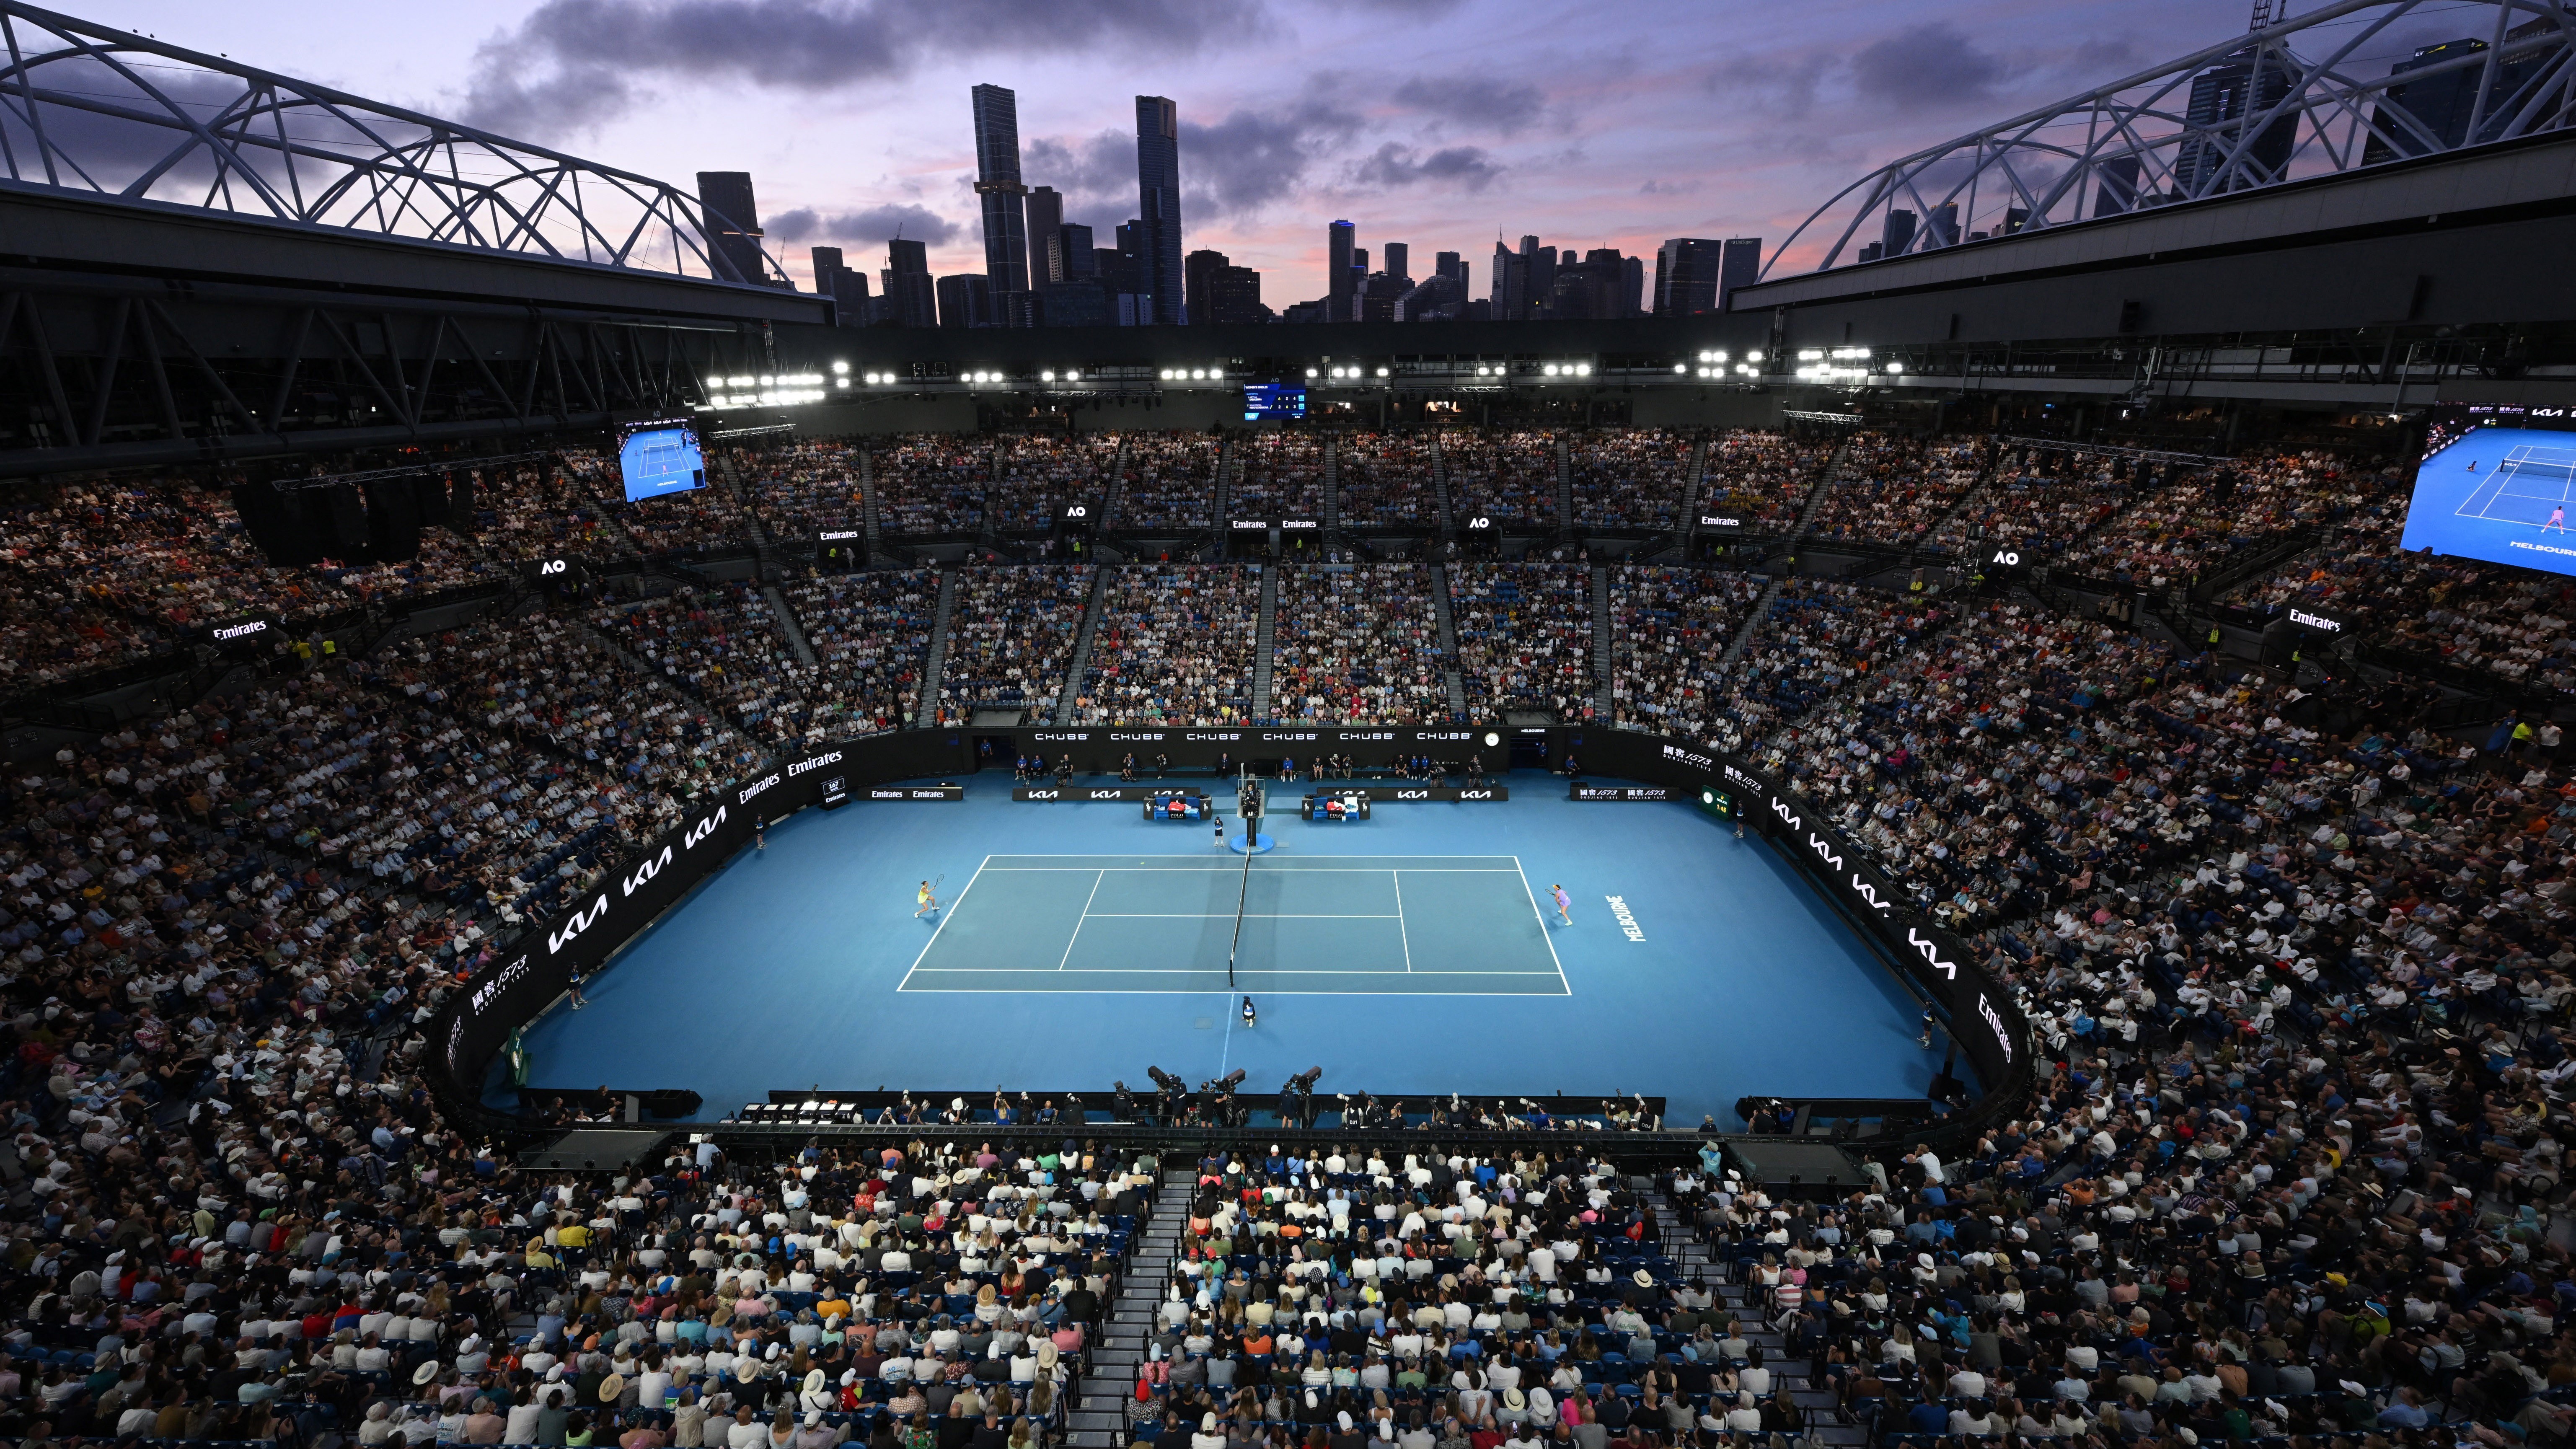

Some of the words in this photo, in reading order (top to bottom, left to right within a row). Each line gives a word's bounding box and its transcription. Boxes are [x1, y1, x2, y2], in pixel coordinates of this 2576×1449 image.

[1067, 507, 1085, 516] AO
[1469, 518, 1489, 528] AO
[1702, 516, 1739, 526] Emirates
[820, 531, 858, 540] Emirates
[542, 560, 566, 574] AO
[1993, 551, 2019, 565] AO
[213, 621, 266, 640] Emirates
[2290, 610, 2341, 632] Emirates
[788, 751, 842, 777] Emirates
[1663, 754, 1692, 765] GUOJIAO
[739, 773, 779, 805] Emirates
[825, 793, 846, 803] Emirates
[1725, 774, 1747, 789] GUOJIAO
[1750, 789, 1760, 798] 1573
[1717, 804, 1726, 813] 1:46
[1772, 797, 1800, 830] KIA
[685, 805, 726, 850] KIA
[1810, 833, 1842, 871] KIA
[623, 846, 672, 896] KIA
[1853, 874, 1891, 917] KIA
[548, 894, 608, 954] KIA
[1605, 895, 1646, 942] MELBOURNE
[1909, 928, 1956, 980] KIA
[476, 985, 506, 1016] GUOJIAO
[511, 967, 529, 983] 1573
[1979, 992, 2012, 1063] Emirates
